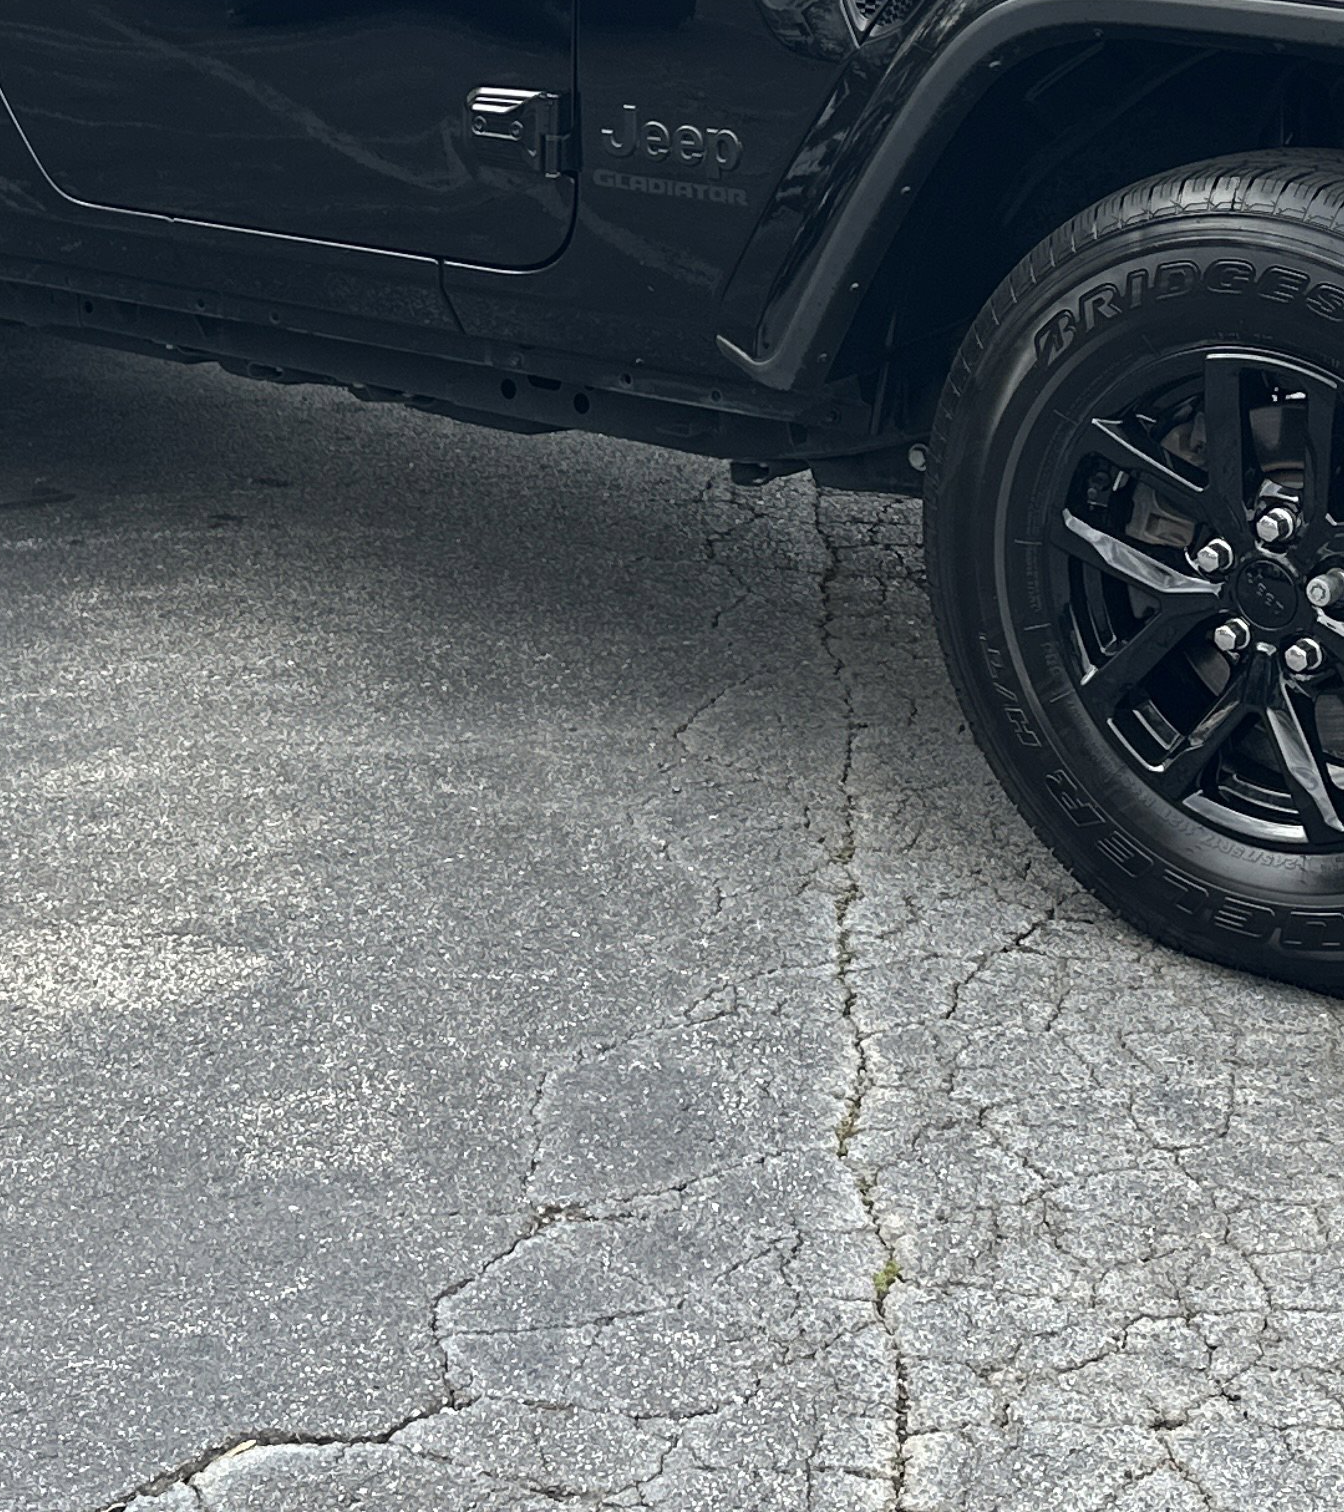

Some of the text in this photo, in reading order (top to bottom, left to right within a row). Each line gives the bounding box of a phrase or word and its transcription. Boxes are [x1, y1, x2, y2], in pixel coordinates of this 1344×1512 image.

[600, 104, 744, 180] Jeep
[592, 168, 750, 207] GLADIATOR
[978, 632, 1042, 748] H/T
